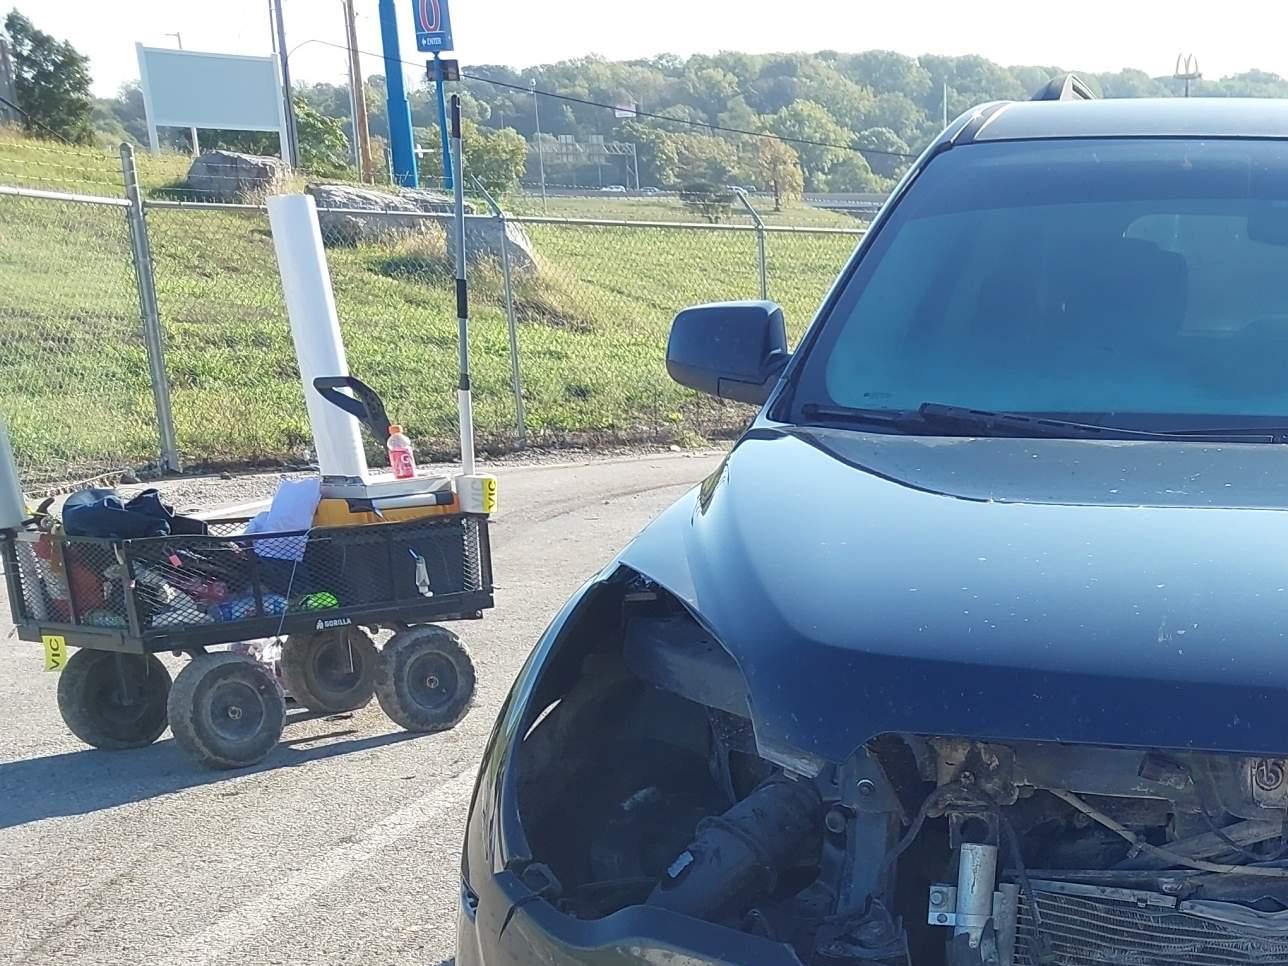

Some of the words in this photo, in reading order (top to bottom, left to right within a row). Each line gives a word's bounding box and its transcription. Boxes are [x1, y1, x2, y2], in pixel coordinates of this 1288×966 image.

[488, 480, 497, 510] VIC
[324, 617, 352, 628] GORILLA
[49, 638, 61, 671] VIC
